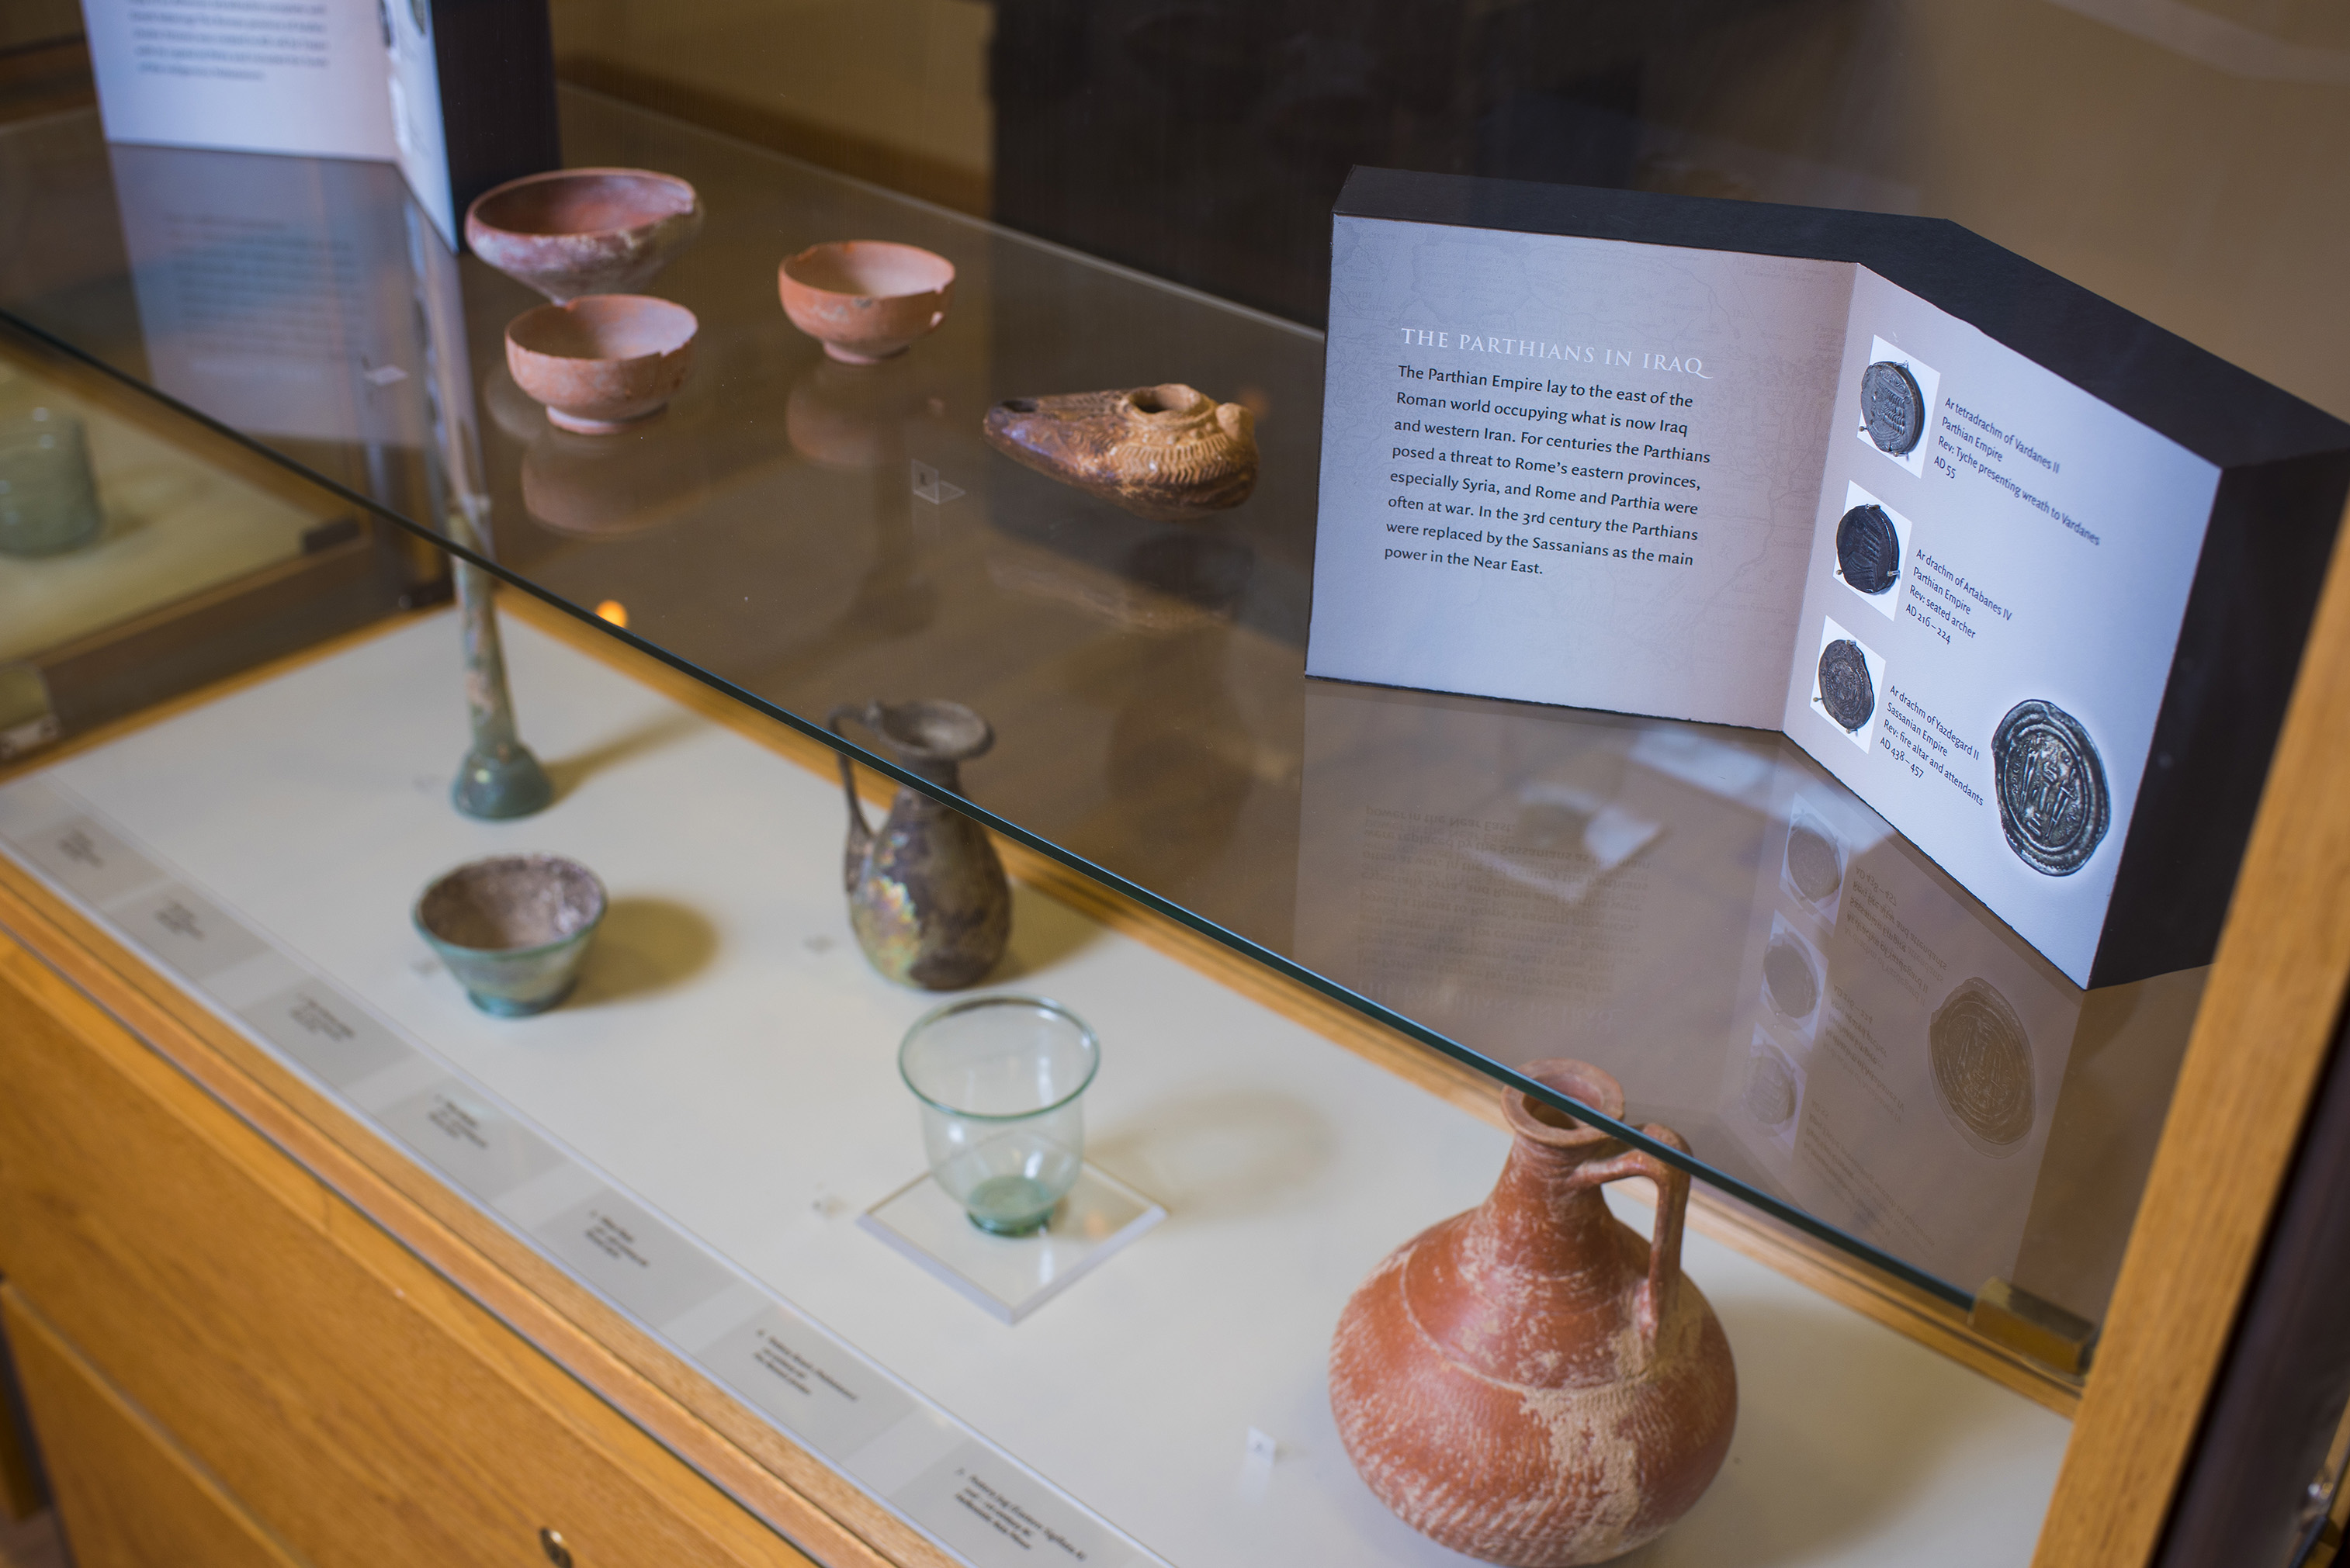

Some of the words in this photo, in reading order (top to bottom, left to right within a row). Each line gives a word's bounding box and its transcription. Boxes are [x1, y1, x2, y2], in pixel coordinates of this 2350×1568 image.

[1400, 327, 1448, 348] THE
[1459, 334, 1595, 363] PARTHIANS
[1605, 349, 1632, 367] IN
[1643, 353, 1714, 379] IRAQ
[1398, 365, 1424, 379] The
[1428, 368, 1488, 386] Parthian
[1492, 374, 1543, 393] Empire
[1547, 379, 1568, 397] lay
[1570, 383, 1586, 396] to
[1589, 384, 1613, 400] the
[1616, 390, 1648, 403] east
[1649, 391, 1669, 404] of
[1669, 393, 1693, 408] the
[1396, 391, 1447, 409] Roman
[1450, 399, 1491, 414] world
[1494, 405, 1568, 425] occupying
[1571, 410, 1607, 426] what
[1610, 413, 1621, 427] is
[1625, 419, 1656, 431] now
[1659, 419, 1688, 438] Iraq
[1944, 396, 1955, 410] Ar
[1955, 403, 2003, 440] tetradrachm
[2003, 434, 2016, 446] of
[2015, 438, 2052, 470] Vardanes
[2052, 462, 2061, 474] II
[1394, 419, 1421, 432] and
[1424, 424, 1480, 439] western
[1484, 427, 1516, 443] Iran.
[1520, 431, 1544, 445] For
[1545, 437, 1613, 453] centuries
[1615, 441, 1640, 456] the
[1643, 444, 1711, 464] Parthians
[1941, 416, 1974, 445] Parthian
[1974, 436, 2003, 462] Empire
[1392, 447, 1435, 460] posed
[1438, 452, 1447, 462] a
[1450, 449, 1494, 467] threat
[1496, 456, 1511, 469] to
[1515, 457, 1568, 475] Rome’s
[1571, 466, 1624, 481] eastern
[1627, 472, 1700, 492] provinces,
[1933, 455, 1946, 469] AD
[1945, 465, 1957, 479] 55
[1390, 472, 1459, 491] especially
[1461, 477, 1500, 496] Syria,
[1504, 483, 1531, 497] and
[1535, 485, 1576, 502] Rome
[1579, 492, 1607, 505] and
[1610, 493, 1660, 511] Parthia
[1664, 503, 1698, 515] were
[1938, 435, 1955, 455] Rev:
[1956, 445, 1978, 469] Tyche
[1977, 463, 2022, 499] presenting
[2022, 490, 2050, 514] wreath
[2050, 507, 2061, 521] to
[2061, 512, 2101, 546] Vardanes
[1388, 495, 1424, 511] often
[1427, 501, 1442, 513] at
[1444, 504, 1474, 517] war.
[1478, 505, 1492, 518] In
[1496, 507, 1519, 521] the
[1522, 511, 1546, 525] 3rd
[1548, 516, 1603, 533] century
[1605, 518, 1628, 533] the
[1631, 521, 1698, 541] Parthians
[1384, 548, 1428, 561] power
[1430, 549, 1444, 563] in
[1447, 552, 1470, 566] the
[1473, 555, 1508, 570] Near
[1510, 559, 1543, 575] East.
[1385, 523, 1419, 535] were
[1423, 526, 1483, 542] replaced
[1486, 531, 1503, 548] by
[1506, 533, 1529, 548] the
[1532, 536, 1609, 557] Sassanians
[1612, 549, 1628, 559] as
[1631, 547, 1655, 562] the
[1658, 552, 1693, 566] main
[1913, 566, 1943, 596] Parthian
[1944, 588, 1971, 615] Empire
[1915, 549, 1926, 561] Ar
[1925, 555, 1955, 583] drachm
[1955, 577, 1964, 589] of
[1964, 582, 2002, 615] Artabanes
[2002, 608, 2013, 621] IV
[1905, 603, 1917, 617] AD
[1909, 584, 1925, 604] Rev:
[1925, 598, 1951, 621] seated
[1950, 617, 1976, 639] archer
[1879, 736, 1891, 750] AD
[1887, 701, 1922, 736] Sassanian
[1922, 729, 1948, 757] Empire
[1889, 684, 1899, 697] Ar
[1898, 692, 1928, 720] drachm
[1927, 714, 1936, 724] of
[1935, 718, 1974, 756] Yazdegard
[1973, 749, 1980, 761] II
[1884, 718, 1899, 738] Rev:
[1899, 731, 1912, 749] fire
[1912, 744, 1929, 761] altar
[1929, 758, 1944, 774] and
[1943, 770, 1984, 806] attendants
